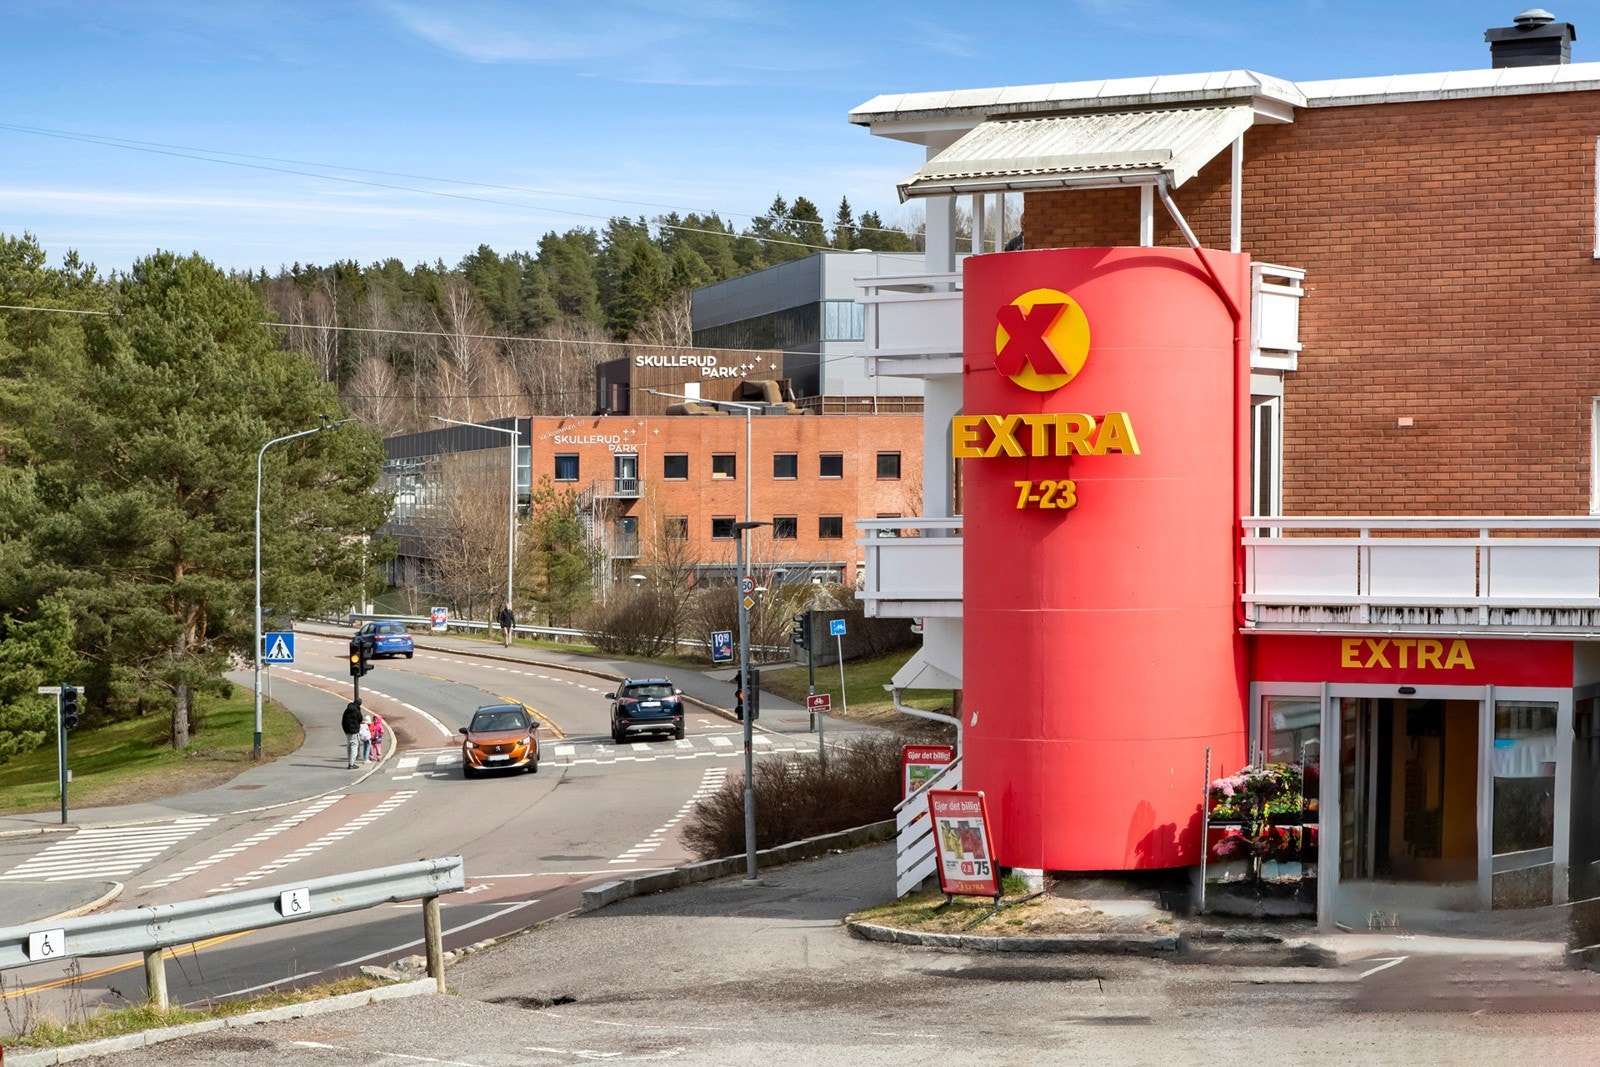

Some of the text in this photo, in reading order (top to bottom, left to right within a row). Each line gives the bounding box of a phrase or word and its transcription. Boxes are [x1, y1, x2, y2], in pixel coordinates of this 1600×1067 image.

[994, 302, 1070, 377] X
[636, 355, 717, 367] SKULLERUD
[701, 366, 739, 378] PARK
[554, 435, 621, 444] SKULLERUD
[952, 411, 1141, 458] EXTRA
[608, 444, 638, 453] PARK
[1014, 480, 1077, 509] 7-23
[1341, 638, 1475, 670] EXTRA
[933, 752, 951, 761] billig!
[949, 801, 961, 811] det
[961, 801, 981, 812] billig!
[974, 860, 990, 875] 75
